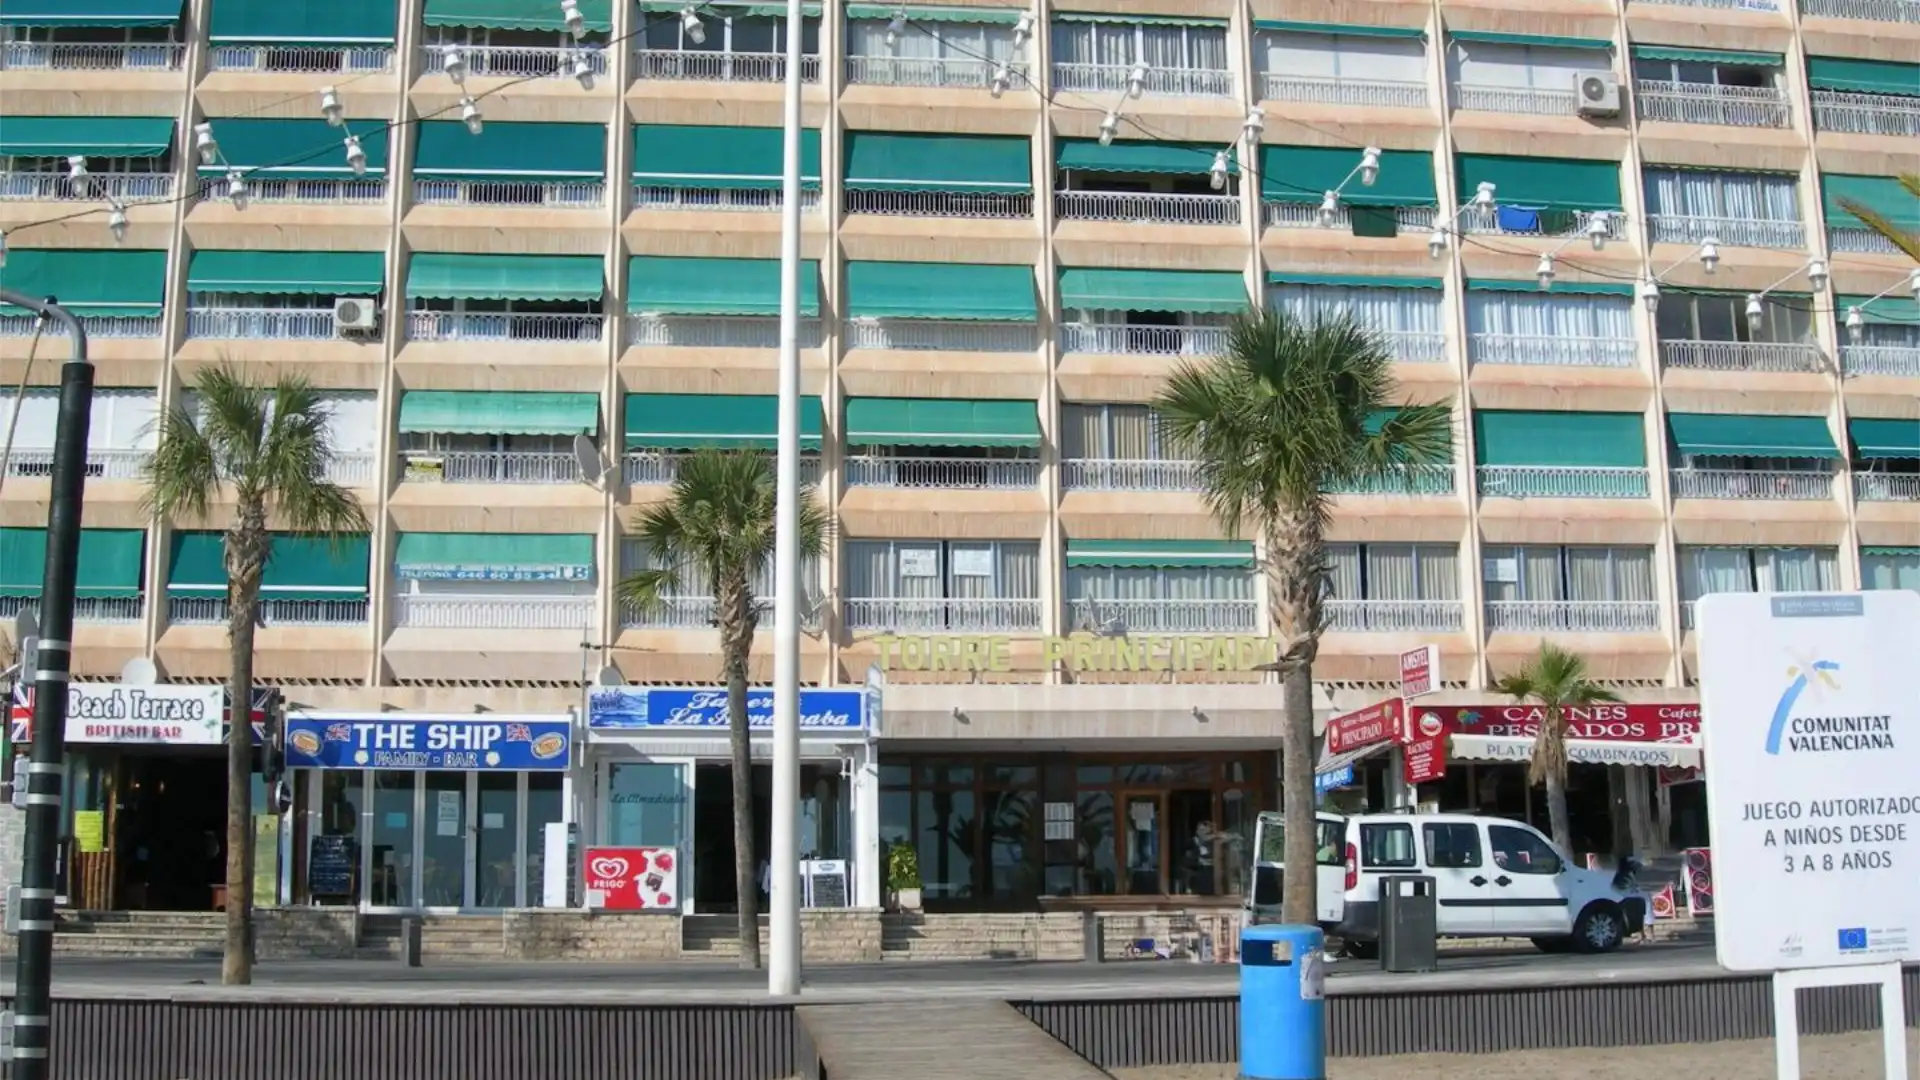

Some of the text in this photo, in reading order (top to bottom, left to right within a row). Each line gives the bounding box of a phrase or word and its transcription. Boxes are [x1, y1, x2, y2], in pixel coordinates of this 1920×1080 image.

[874, 635, 1011, 671] TORRE
[1403, 650, 1430, 669] AMSTEL
[67, 688, 205, 721] Beach Terrace
[1503, 706, 1628, 721] CANES
[664, 707, 702, 725] La
[1791, 715, 1892, 734] COMUNITAT
[85, 724, 183, 740] BRITISH BAR
[353, 723, 502, 750] THE SHIP
[1486, 722, 1645, 738] PESADOS
[1788, 733, 1895, 752] VALENCIANA
[374, 751, 430, 766] FAMILY
[443, 751, 479, 766] BAR
[1568, 747, 1670, 763] COMBINADOS
[1742, 801, 1802, 821] JUEGO
[1763, 823, 1908, 847] A NIÑOS DESDE
[1784, 848, 1892, 873] 3 A 8 AÑOS
[593, 880, 626, 889] FRIGO
